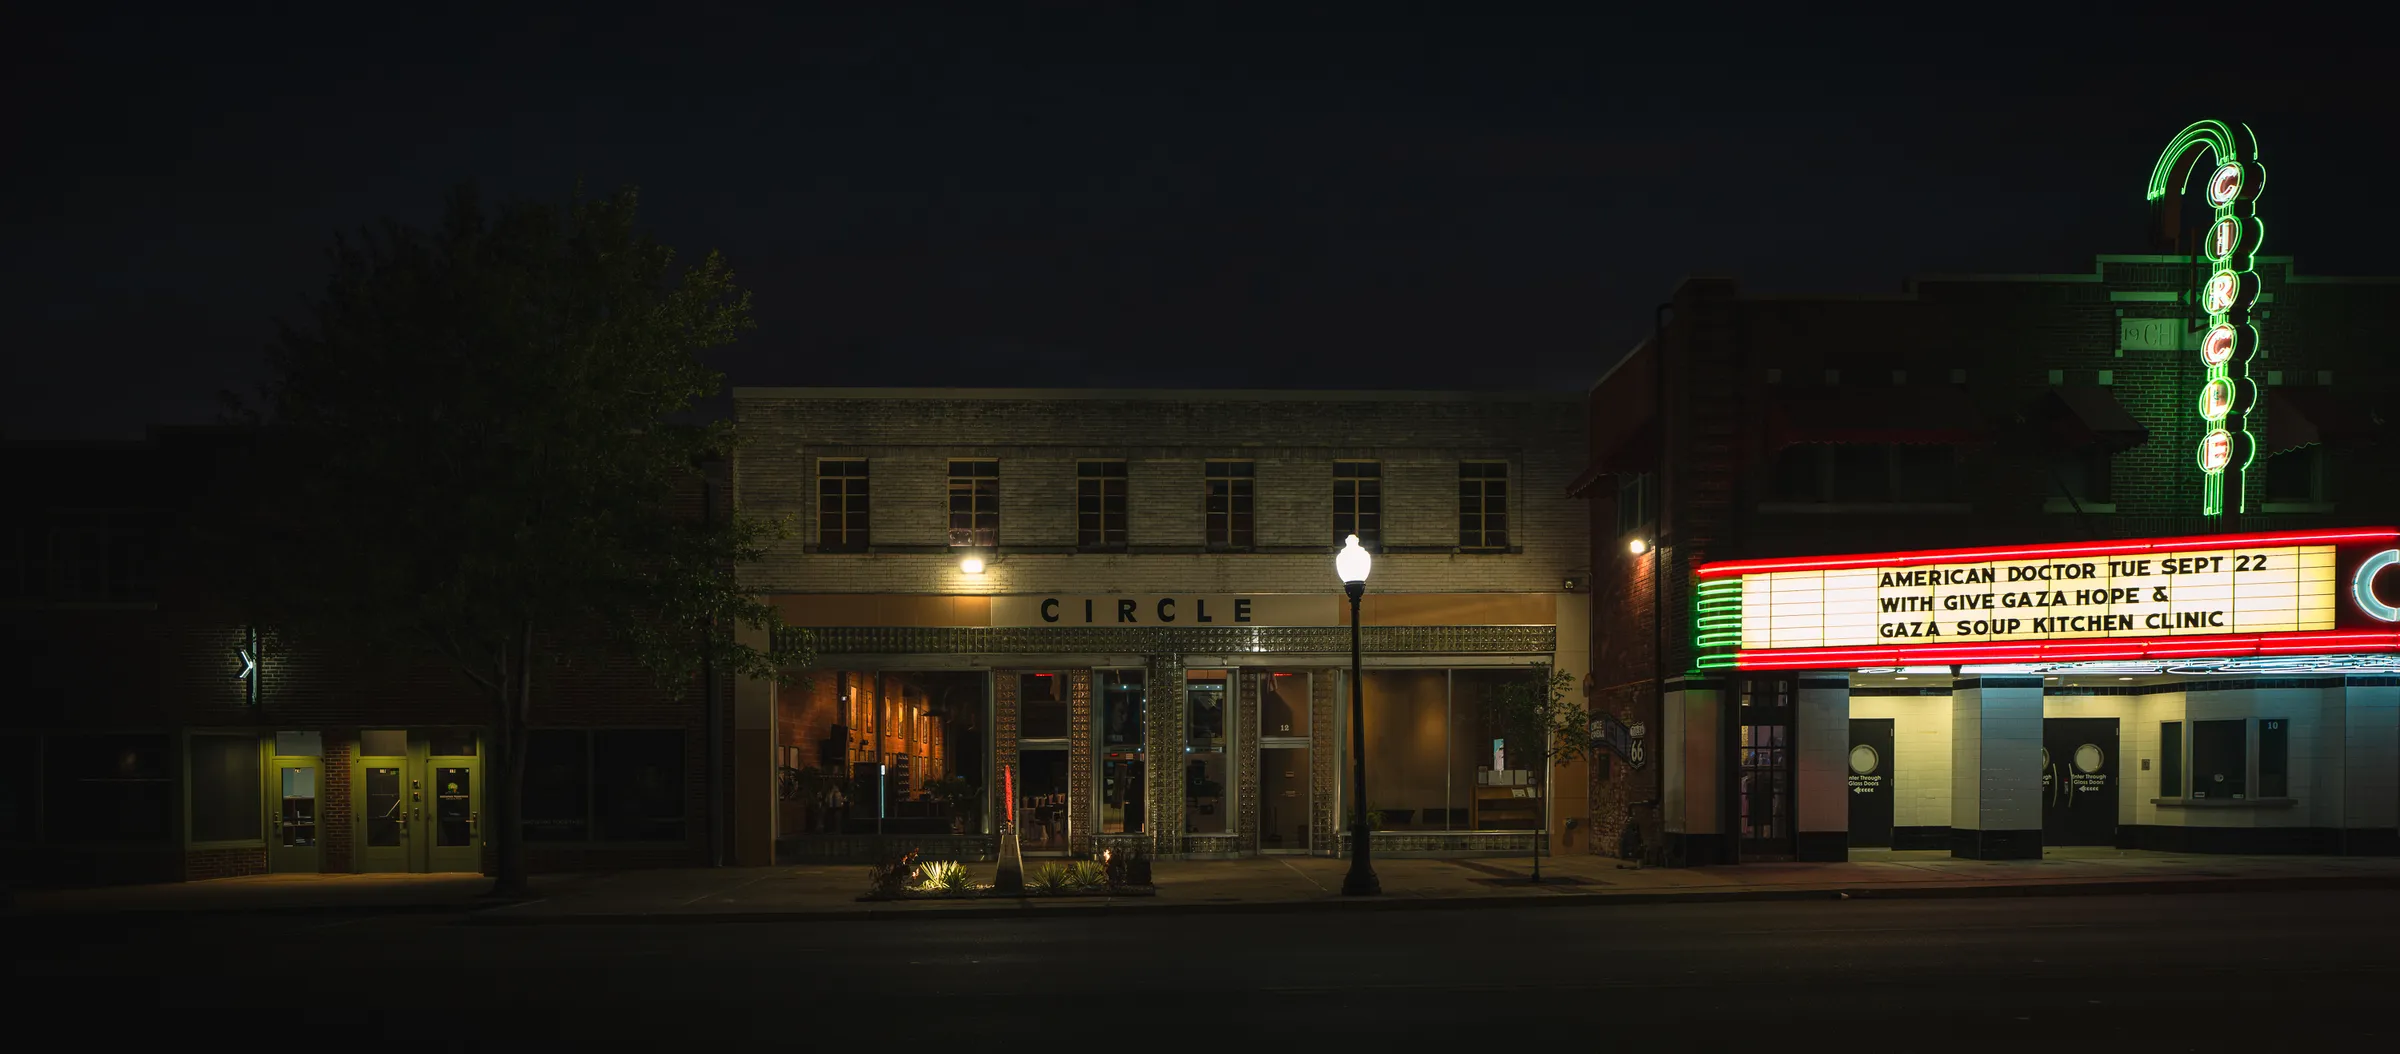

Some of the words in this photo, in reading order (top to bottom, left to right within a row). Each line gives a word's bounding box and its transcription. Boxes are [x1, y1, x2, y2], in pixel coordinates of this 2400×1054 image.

[2206, 164, 2238, 471] CIRCLE
[1880, 567, 1995, 588] AMERICAN
[2008, 563, 2096, 582] DOCTOR
[2109, 560, 2151, 578] TUE
[2161, 556, 2223, 574] SEPT
[2235, 555, 2267, 572] 22
[1041, 598, 1251, 622] CIRCLE
[1880, 596, 1933, 613] WITH
[1943, 593, 1995, 610] GIVE
[2002, 590, 2067, 608] GAZA
[2076, 588, 2140, 605] HOPE
[2152, 586, 2169, 602] &
[1880, 621, 1940, 638] GAZA
[1957, 619, 2020, 636] SOUP
[2033, 614, 2134, 633] KITCHEN
[2145, 611, 2224, 629] CLINIC
[1280, 724, 1290, 732] 12
[2267, 721, 2279, 730] 10
[1631, 740, 1643, 762] 66
